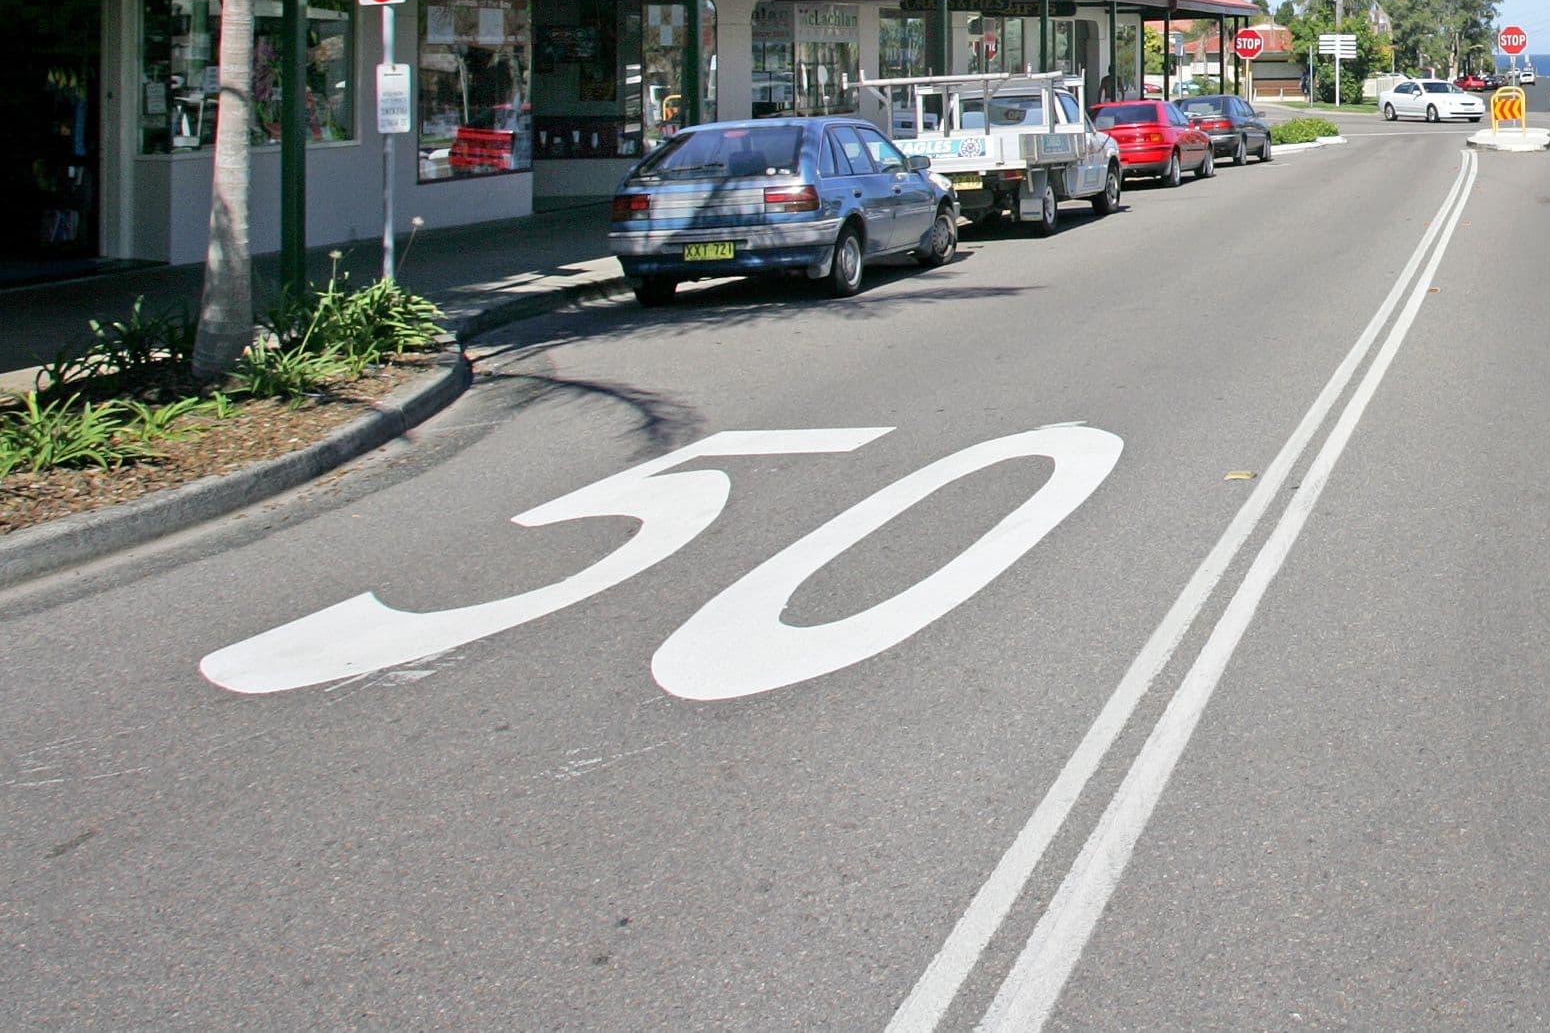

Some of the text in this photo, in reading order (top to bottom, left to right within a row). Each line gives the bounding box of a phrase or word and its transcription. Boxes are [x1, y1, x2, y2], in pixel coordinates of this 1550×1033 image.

[1236, 38, 1261, 50] STOP
[1500, 35, 1526, 46] STOP
[200, 425, 1125, 701] 50
